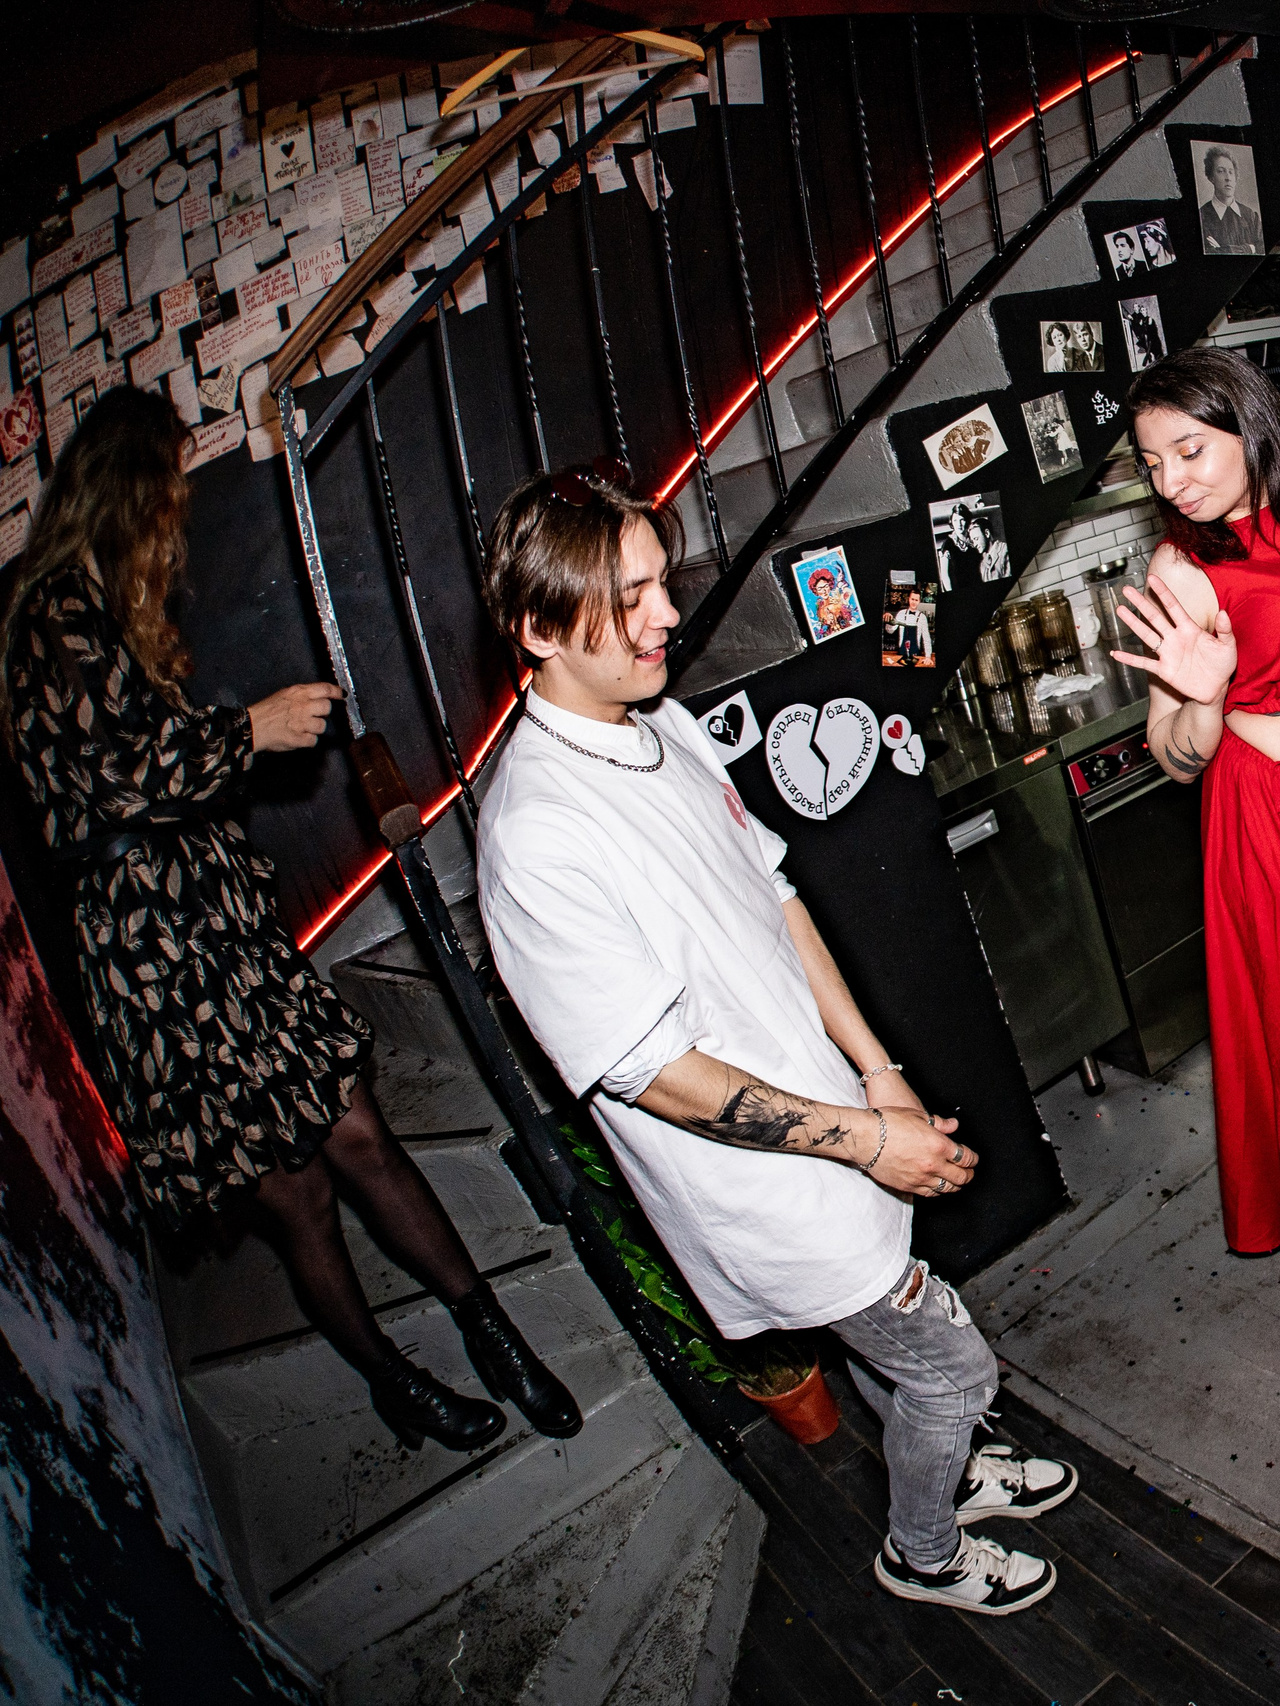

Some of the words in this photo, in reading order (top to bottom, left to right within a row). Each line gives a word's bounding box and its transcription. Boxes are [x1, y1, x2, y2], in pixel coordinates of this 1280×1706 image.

[772, 710, 813, 749] сердец
[826, 703, 873, 780] бильярдный
[772, 753, 825, 815] разбитых
[828, 779, 851, 804] бар
